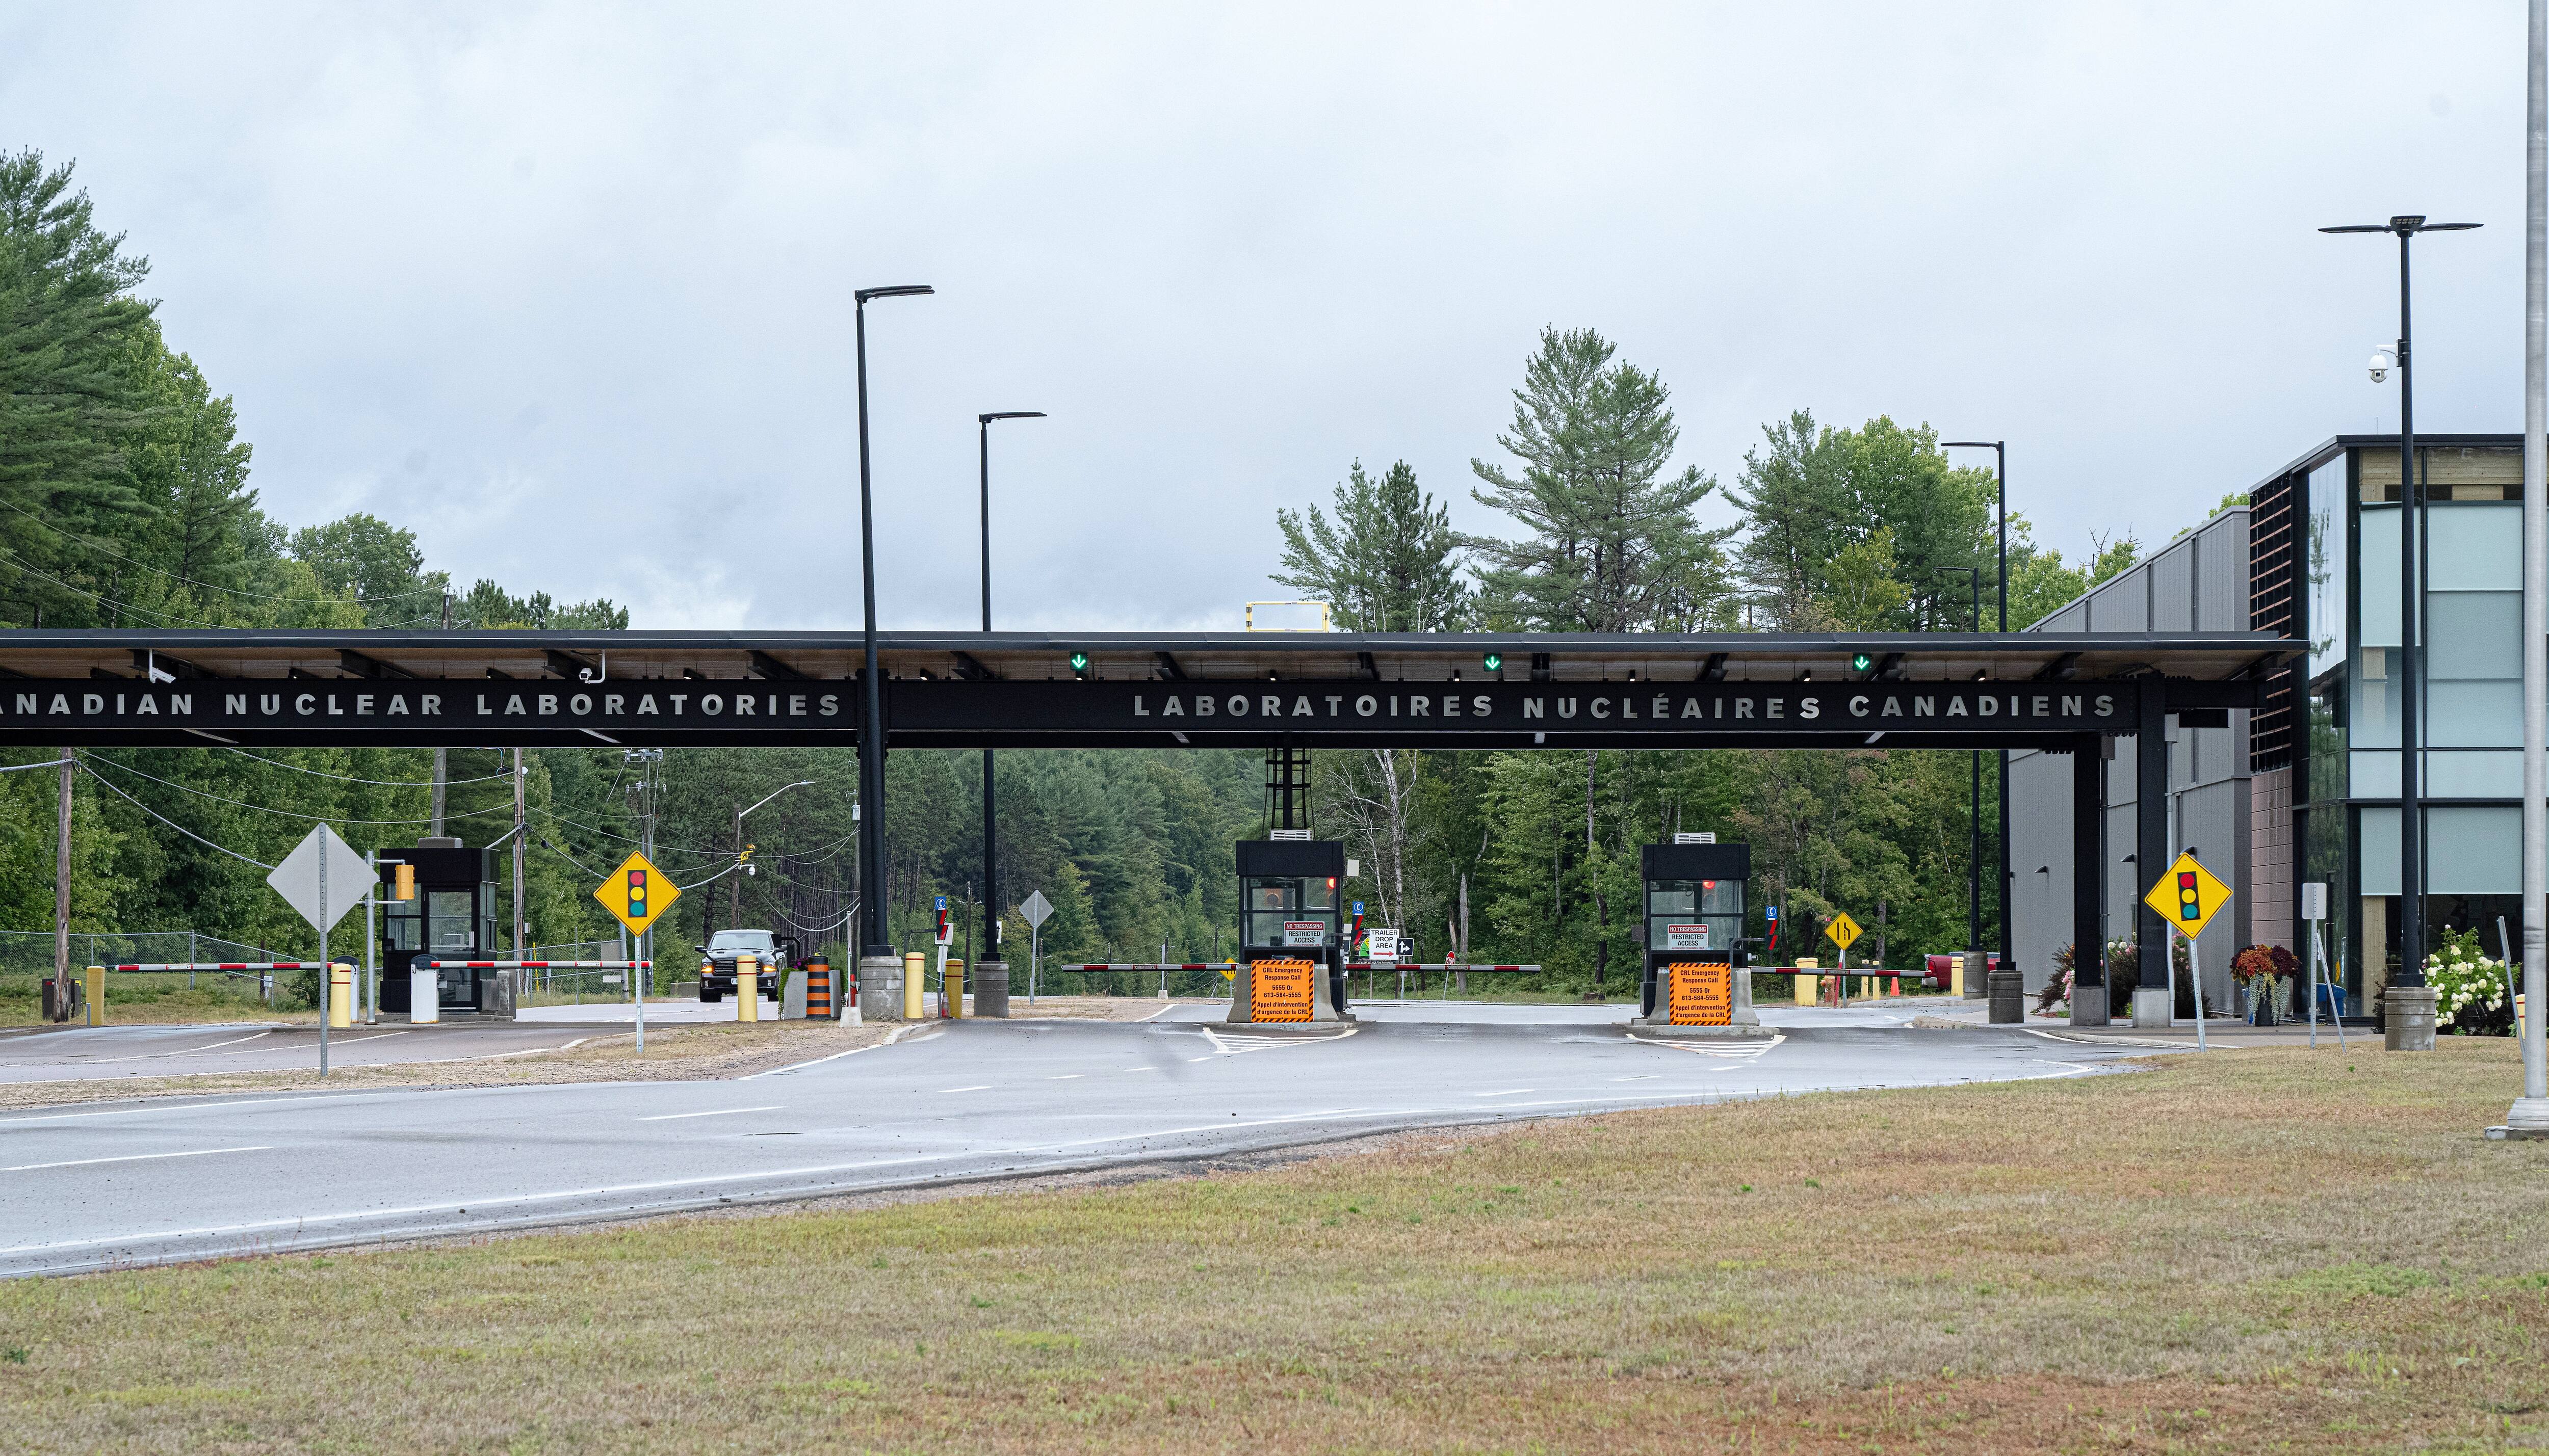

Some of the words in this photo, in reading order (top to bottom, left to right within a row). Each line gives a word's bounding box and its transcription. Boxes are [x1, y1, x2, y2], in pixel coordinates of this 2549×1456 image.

[0, 694, 192, 714] NADIAN
[226, 694, 441, 716] NUCLEAR
[477, 694, 839, 716] LABORATORIES
[1135, 695, 1492, 717] LABORATOIRES
[1524, 693, 1819, 719] NUCLÉAIRES
[1849, 695, 2114, 717] CANADIENS
